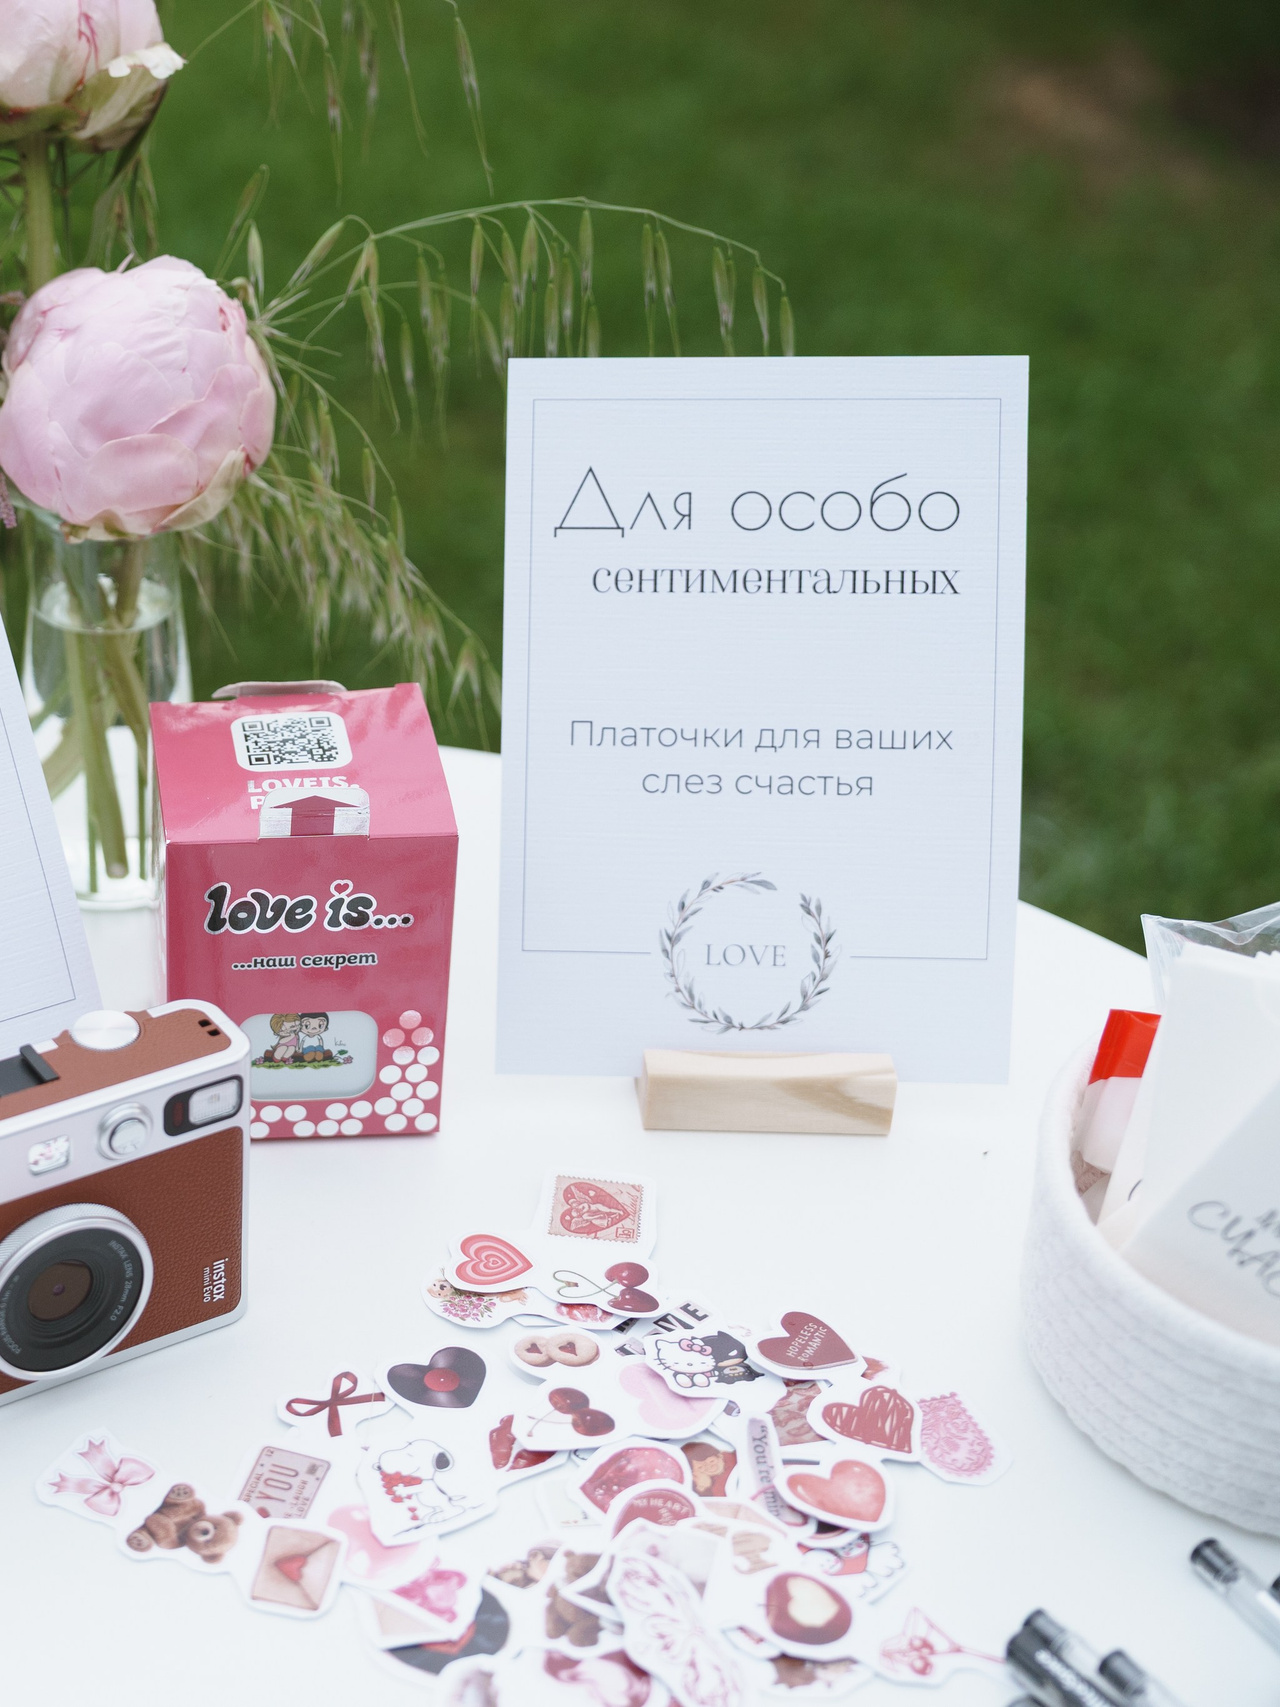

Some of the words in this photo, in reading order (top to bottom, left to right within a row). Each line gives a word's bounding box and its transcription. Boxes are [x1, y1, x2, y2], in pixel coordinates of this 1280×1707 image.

[554, 466, 694, 538] Для
[730, 472, 961, 532] особо
[591, 565, 962, 597] сентиментальных
[569, 718, 744, 750] Платочки
[754, 723, 821, 753] для
[834, 723, 955, 752] ваших
[641, 770, 723, 796] слез
[734, 771, 875, 798] счастья
[204, 881, 316, 935] love
[325, 879, 415, 931] is...
[232, 955, 298, 972] ...наш
[300, 952, 379, 969] секрет
[704, 942, 787, 968] LOVE
[122, 1259, 134, 1278] LENS
[203, 1266, 212, 1286] mini
[212, 1257, 229, 1302] instax
[203, 1285, 213, 1303] Evo
[109, 1304, 124, 1321] F2.0
[785, 1321, 819, 1359] HOPELESS
[796, 1325, 829, 1363] ROMANTIC
[243, 1472, 264, 1503] SPECIAL
[255, 1463, 300, 1503] YOU
[648, 1497, 689, 1514] HEART
[762, 1490, 783, 1518] min
